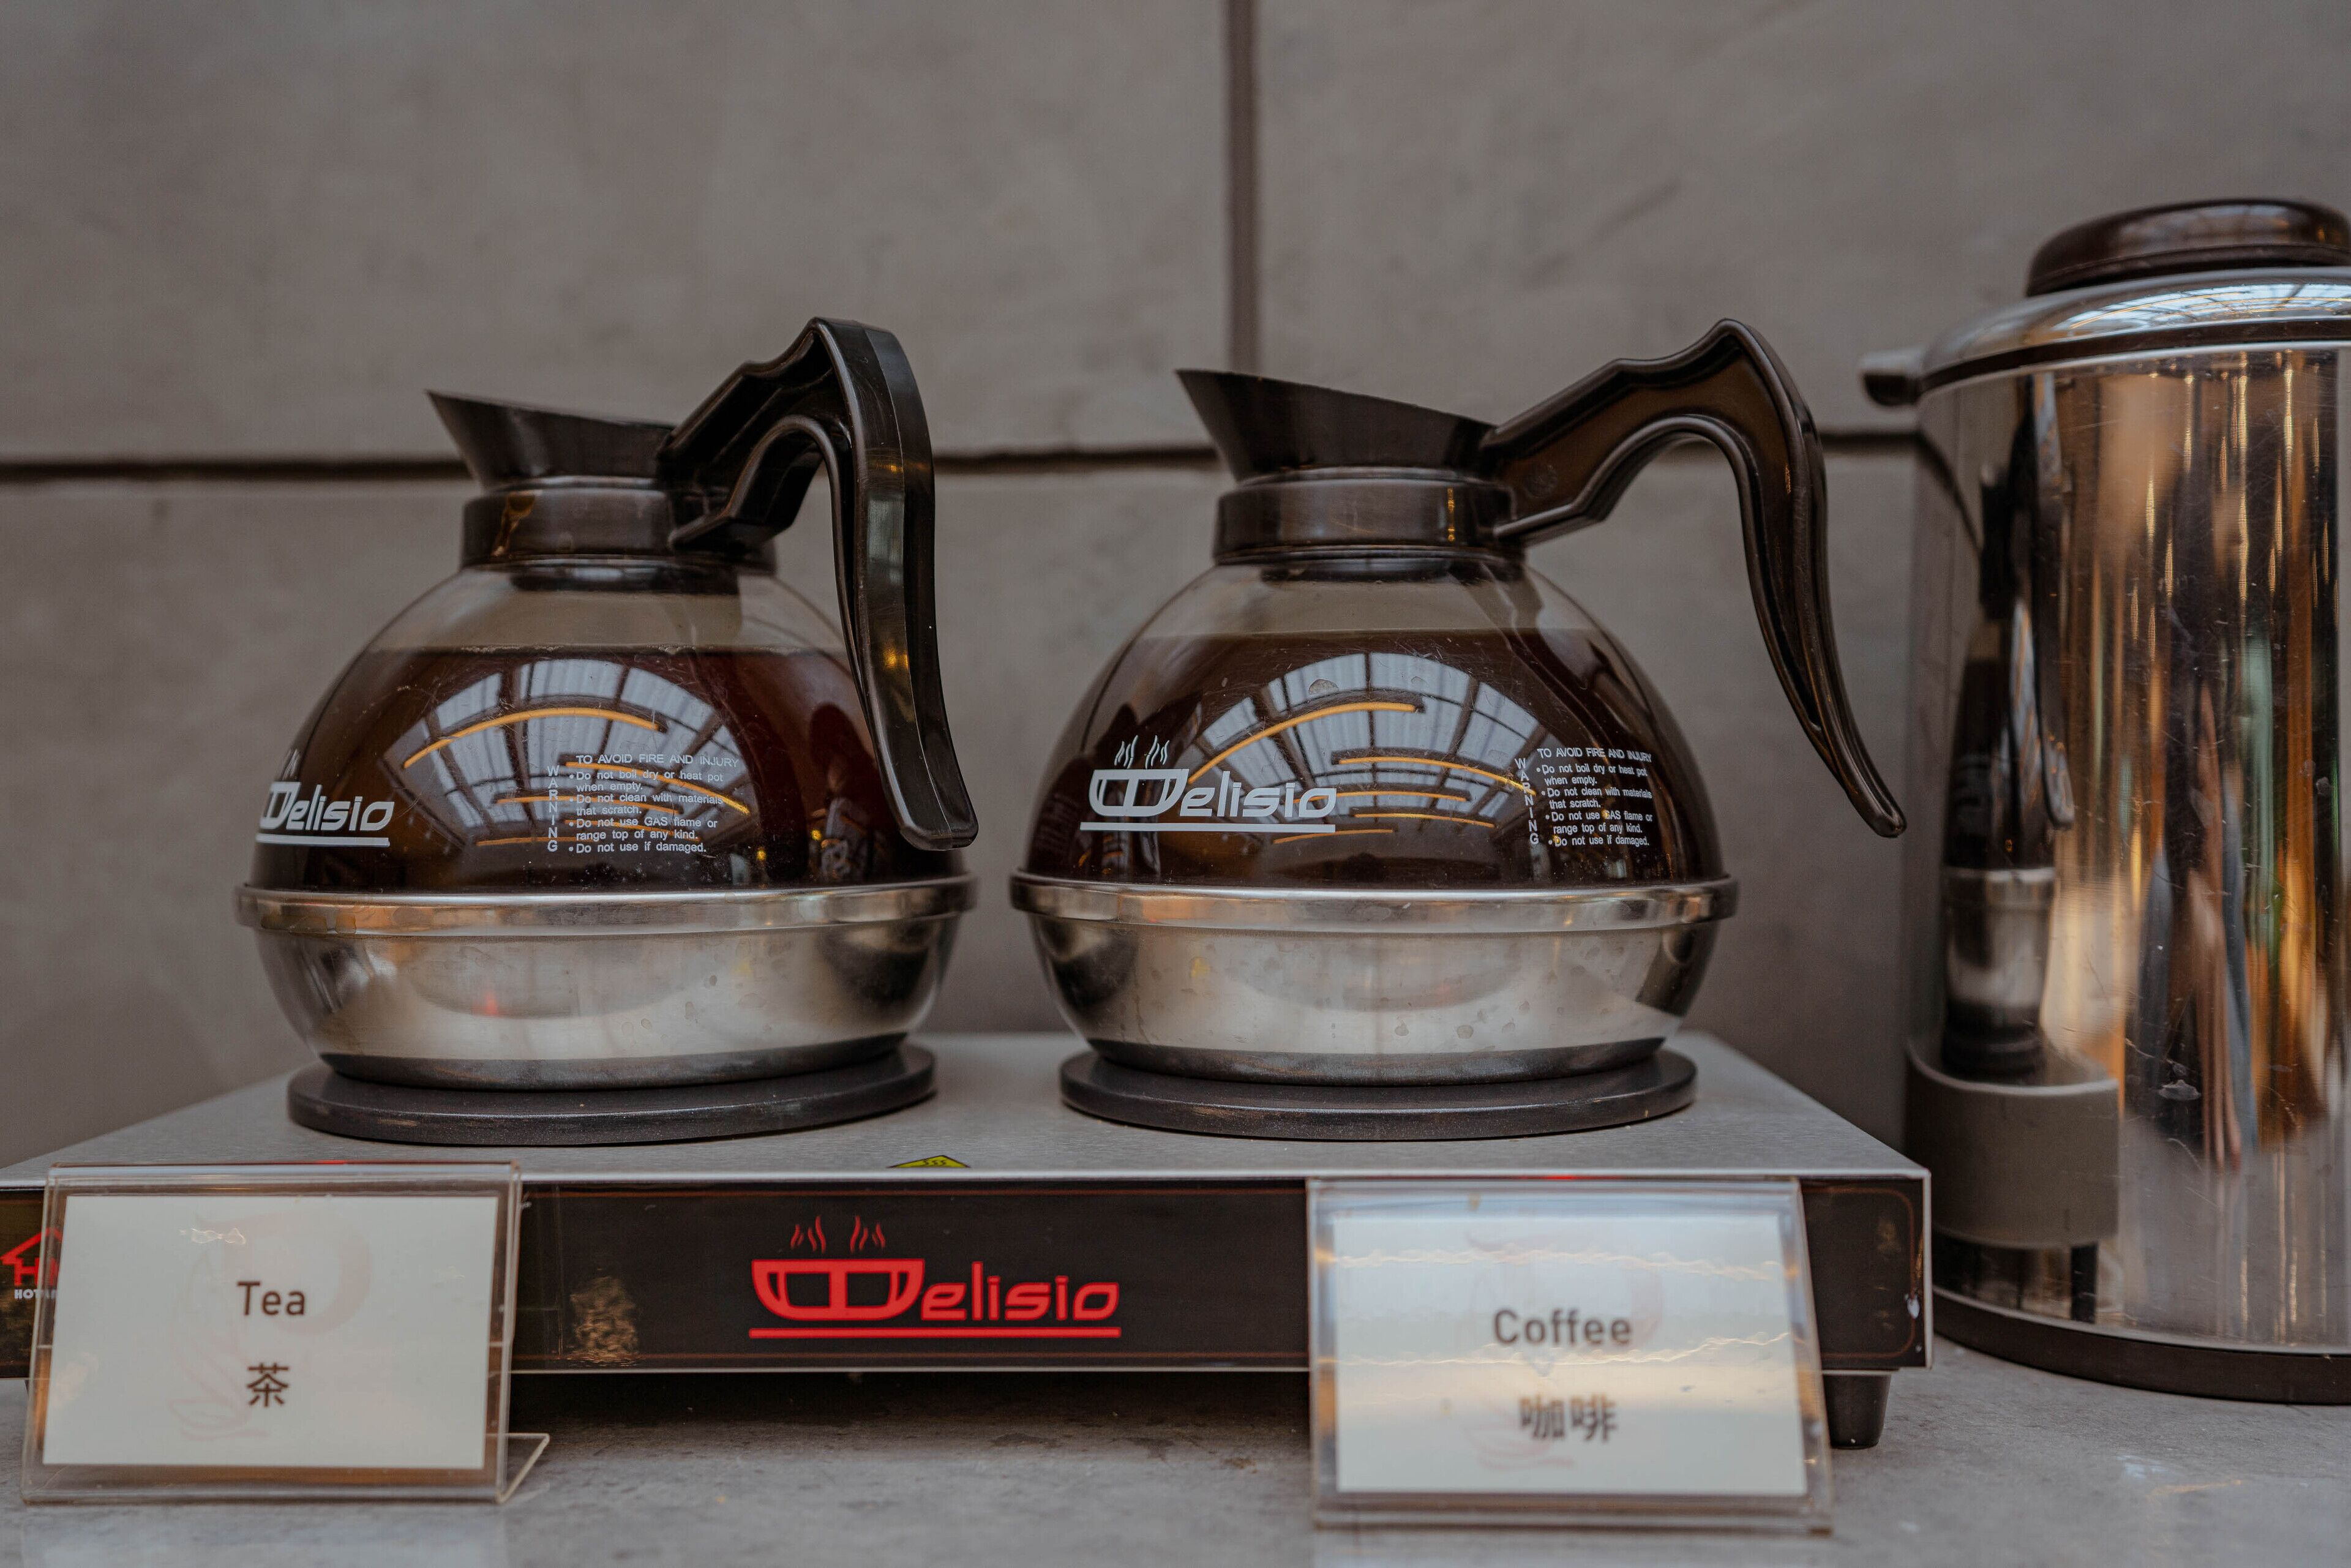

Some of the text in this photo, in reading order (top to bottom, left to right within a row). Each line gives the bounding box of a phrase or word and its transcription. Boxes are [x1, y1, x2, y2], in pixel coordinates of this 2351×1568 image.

[576, 754, 739, 767] TO AVOID FIRE AND INJURY
[1537, 748, 1652, 762] TO AVOID FIRE AND INJURY
[576, 771, 591, 780] Do
[619, 769, 637, 779] boil
[643, 770, 658, 780] dry
[680, 771, 702, 780] heat
[708, 774, 723, 782] pot
[1542, 765, 1554, 775] Do
[1559, 764, 1573, 773] not
[1575, 763, 1590, 773] boil
[1593, 763, 1605, 775] dry
[1618, 765, 1635, 775] heat
[1637, 768, 1648, 777] pot
[576, 782, 643, 792] when empty.
[1545, 775, 1597, 786] when empty.
[576, 795, 591, 803] Do
[619, 793, 647, 801] clean
[652, 793, 672, 802] with
[678, 794, 723, 805] materials
[1089, 768, 1337, 817] Delisio
[1547, 787, 1652, 798] Do not clean with materials
[260, 781, 395, 831] Delisio
[1515, 758, 1539, 845] WARNING
[1549, 798, 1601, 809] that scratch.
[547, 765, 560, 852] WARNING
[602, 805, 642, 814] scratch.
[576, 819, 591, 828] Do
[598, 818, 614, 827] not
[644, 817, 668, 827] GAS
[673, 817, 701, 827] flame
[1551, 812, 1564, 822] Do
[1569, 811, 1582, 820] not
[1603, 810, 1621, 820] GAS
[1624, 811, 1643, 821] flame
[576, 829, 698, 841] range top of any kind.
[1553, 822, 1643, 835] range top of any kind.
[576, 844, 591, 853] Do
[597, 842, 614, 852] not
[644, 841, 651, 851] if
[656, 842, 707, 853] damaged.
[1554, 837, 1567, 847] Do
[1572, 836, 1585, 845] not
[1607, 835, 1612, 844] if
[1615, 835, 1649, 847] damaged.
[751, 1258, 1120, 1322] Delisio
[237, 1280, 306, 1316] Tea
[1493, 1308, 1633, 1346] Coffee
[246, 1362, 290, 1408] 茶
[1518, 1394, 1619, 1443] 咖啡
